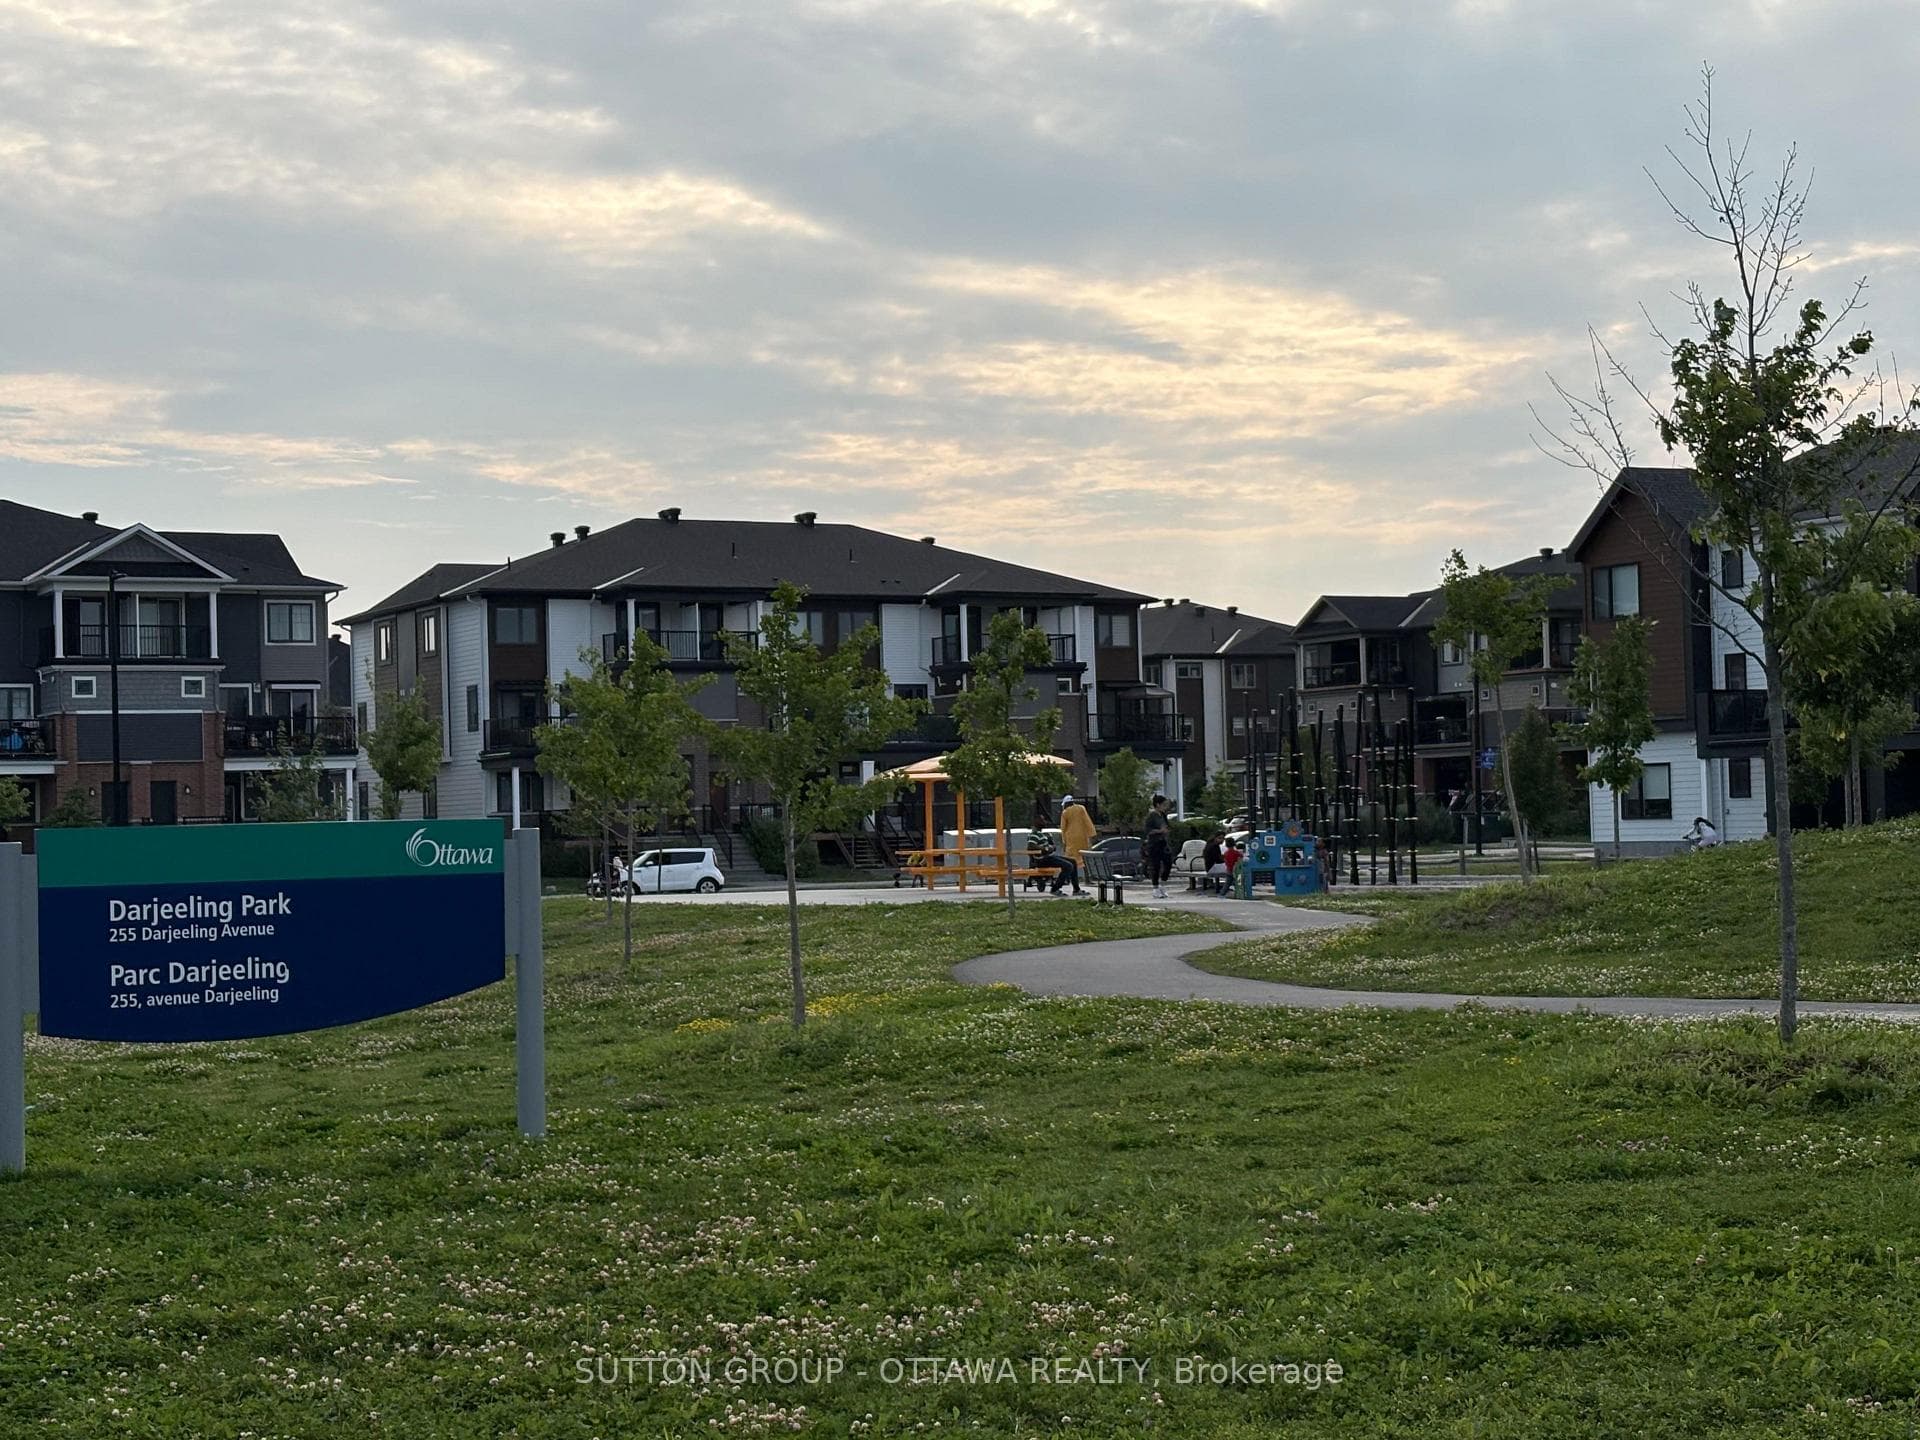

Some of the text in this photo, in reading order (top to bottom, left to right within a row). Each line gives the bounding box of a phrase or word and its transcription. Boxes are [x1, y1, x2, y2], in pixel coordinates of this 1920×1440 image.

[406, 828, 494, 867] Ottawa
[109, 892, 292, 926] Darjeeling Park
[109, 923, 275, 944] 255 Darjeeling Avenue
[110, 956, 290, 988] Parc Darjeeling
[110, 985, 279, 1009] 255, avenue Darjeeling
